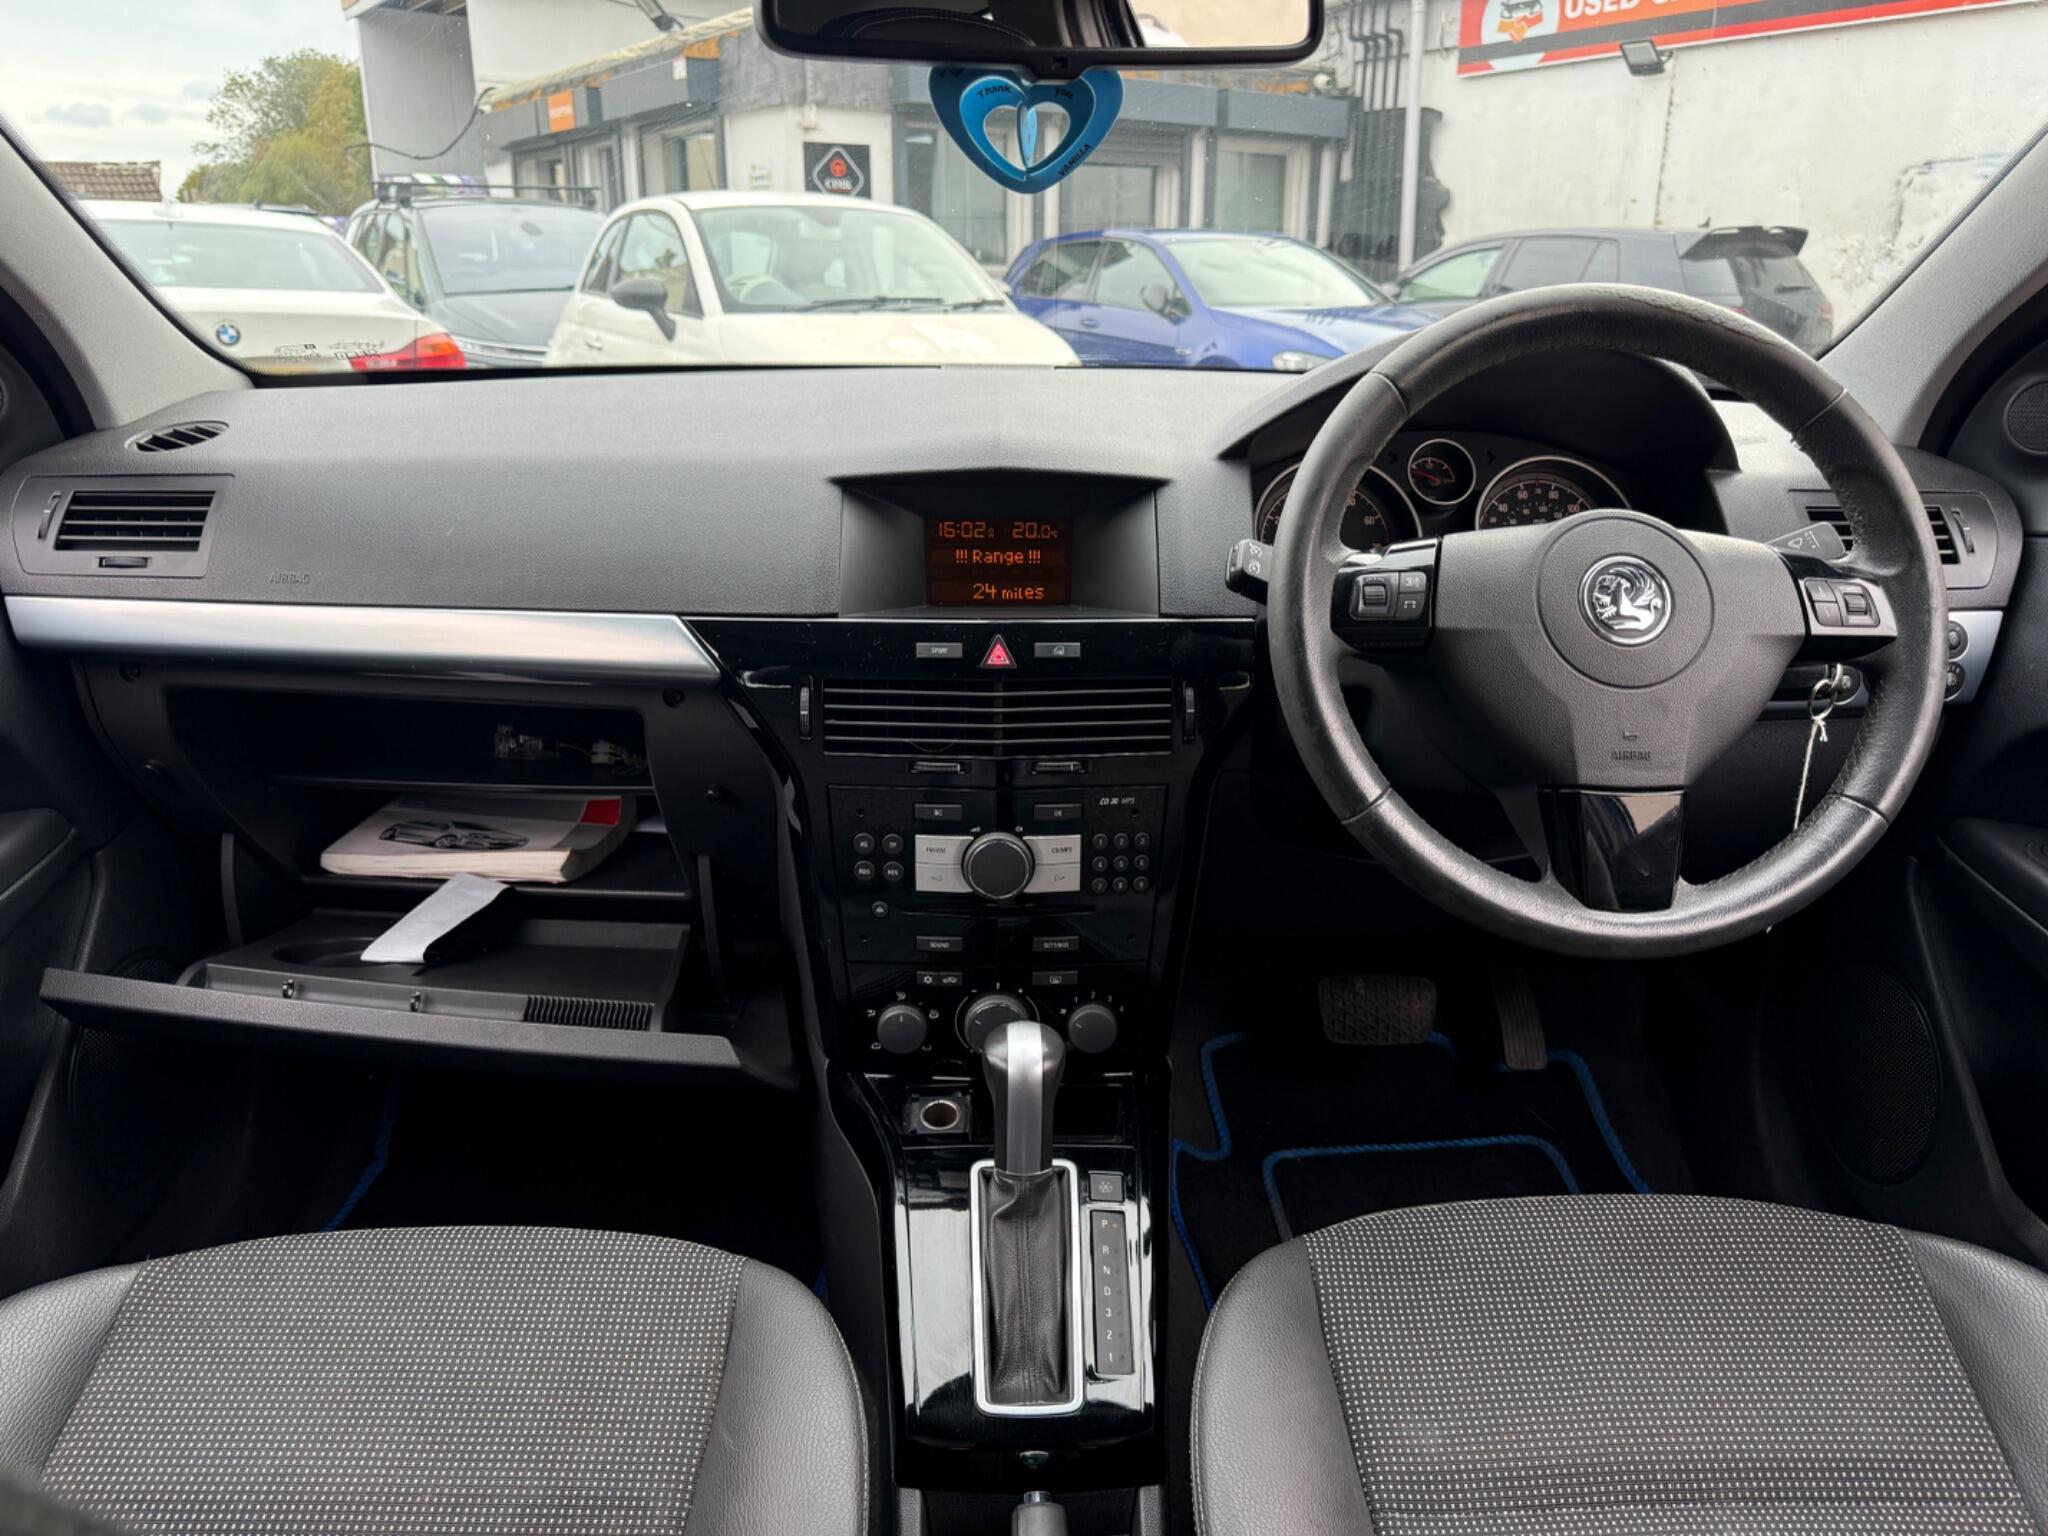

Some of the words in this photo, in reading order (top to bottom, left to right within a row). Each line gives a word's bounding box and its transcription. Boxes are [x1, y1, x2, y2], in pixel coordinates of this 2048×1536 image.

[1058, 144, 1092, 176] VANILLA
[939, 521, 987, 539] 16:02
[973, 549, 1024, 566] Range
[269, 571, 310, 585] AIRBAG
[973, 583, 997, 600] 24
[1001, 587, 1045, 600] miles
[1611, 750, 1652, 762] AIRBAG
[1101, 1220, 1109, 1229] P
[1102, 1245, 1110, 1255] R
[1103, 1266, 1111, 1276] N
[1103, 1287, 1112, 1297] D
[1104, 1308, 1113, 1318] 3
[1106, 1330, 1113, 1340] 2
